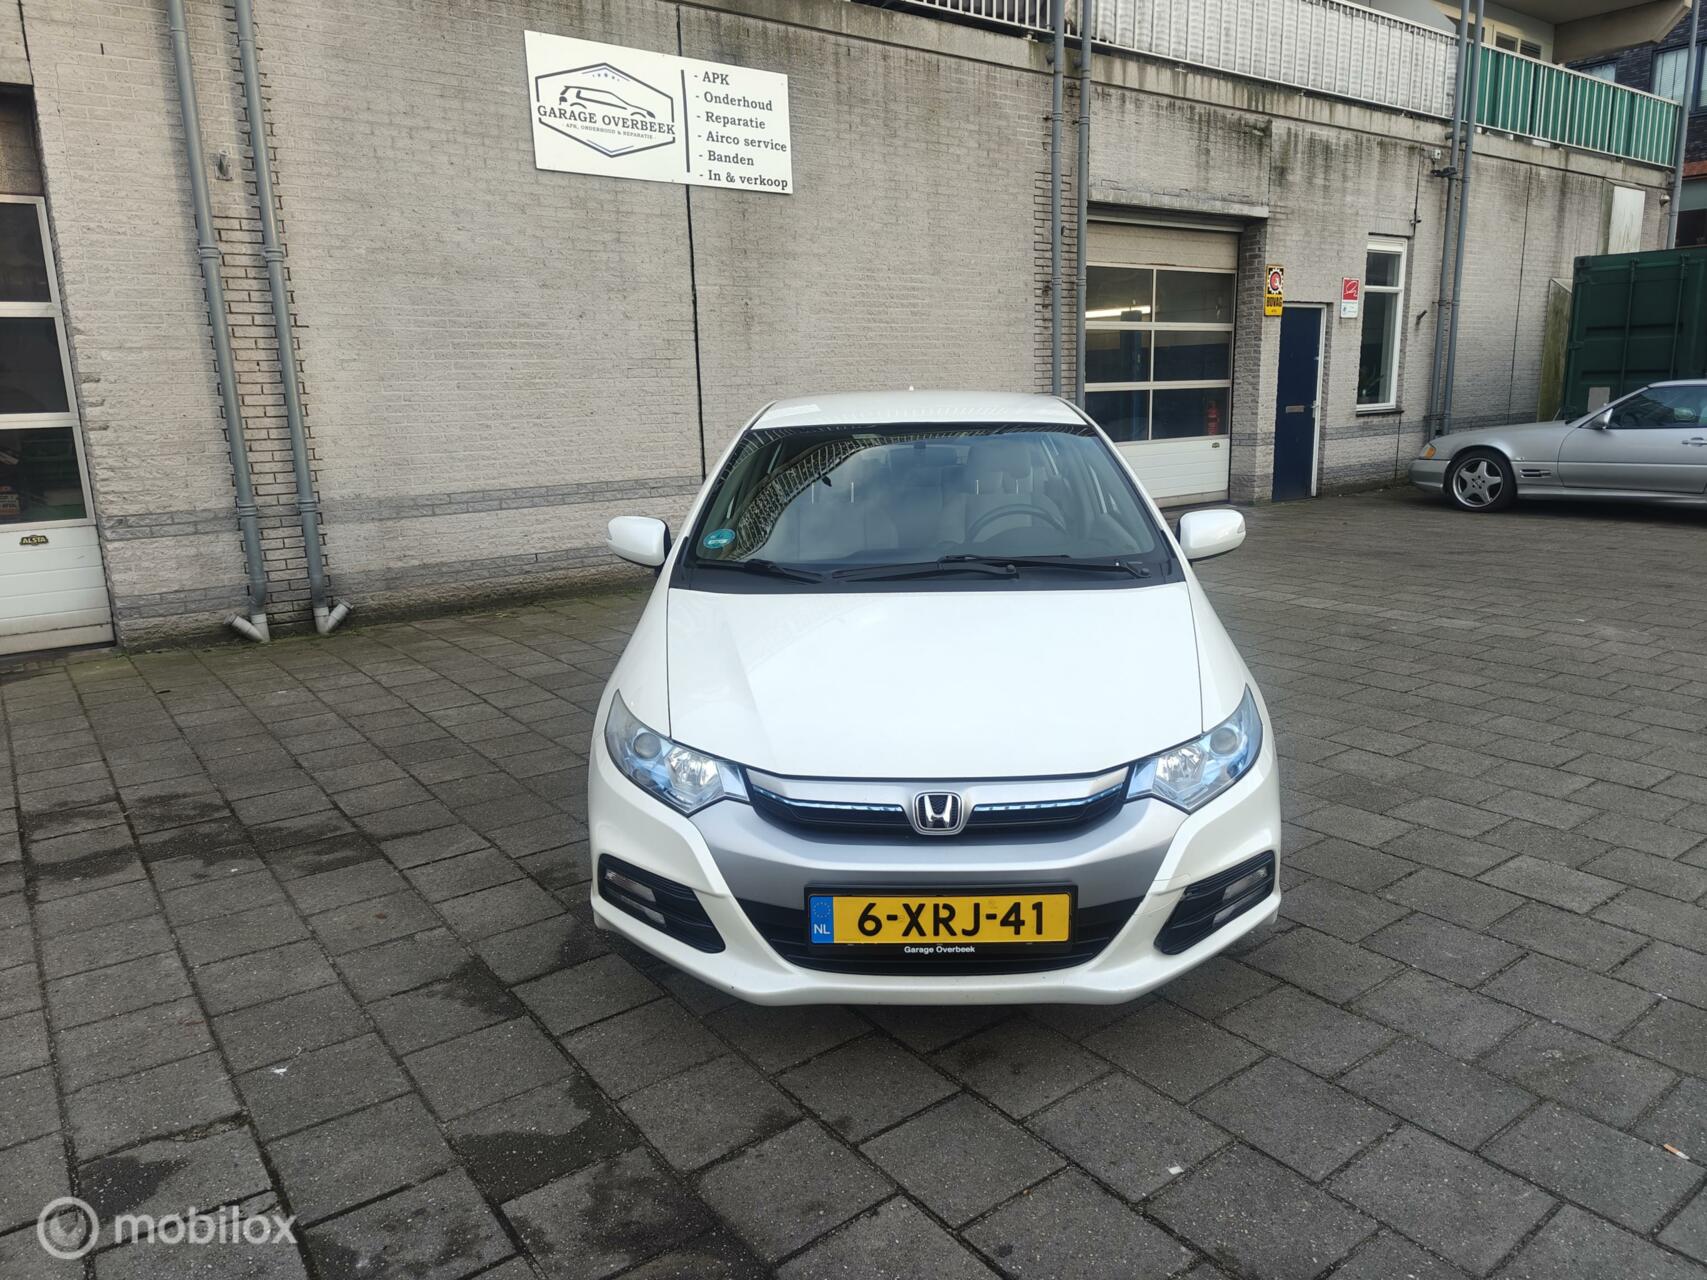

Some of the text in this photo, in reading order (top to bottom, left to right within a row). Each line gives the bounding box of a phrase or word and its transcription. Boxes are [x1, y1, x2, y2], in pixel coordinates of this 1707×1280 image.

[702, 71, 730, 86] APK
[704, 91, 773, 111] Onderhoud
[537, 105, 675, 135] GARAGE OVERBEEK
[705, 111, 766, 129] Reparatie
[706, 131, 787, 152] Airco service
[708, 150, 754, 166] Banden
[708, 170, 788, 190] In & verkoop
[22, 536, 46, 544] ALSTA
[858, 901, 1043, 937] 6-XRJ-41
[814, 924, 830, 935] NL
[904, 945, 975, 955] Garage Overbeek
